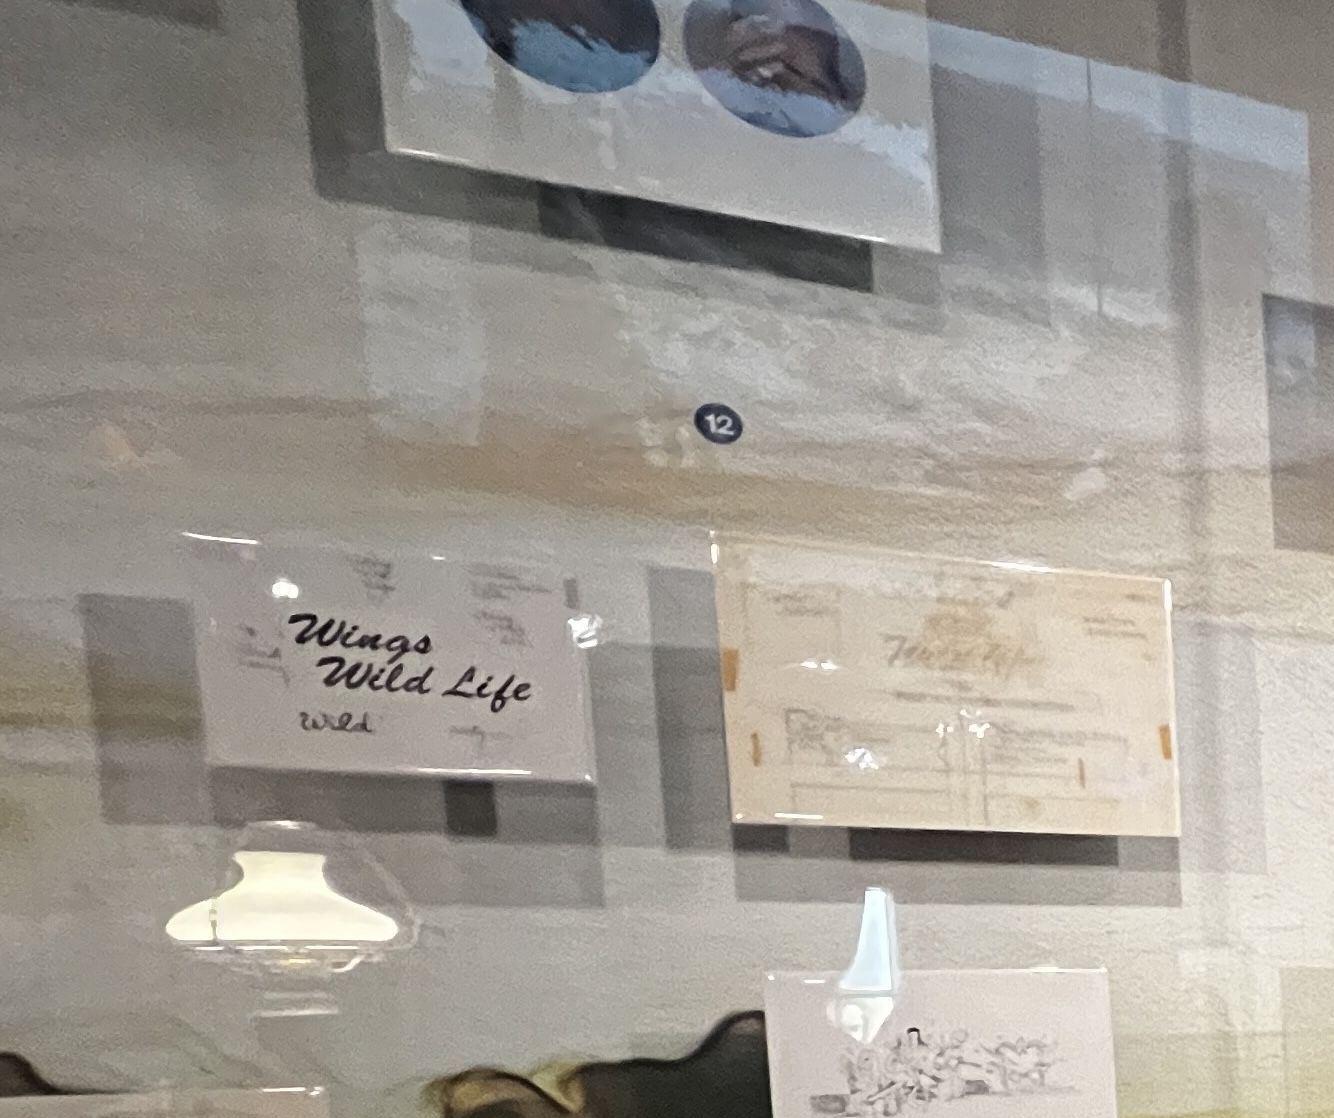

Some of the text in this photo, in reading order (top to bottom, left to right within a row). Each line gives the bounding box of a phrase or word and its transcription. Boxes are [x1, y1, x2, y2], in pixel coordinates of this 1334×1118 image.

[704, 413, 735, 436] 12
[288, 613, 433, 665] Wings
[316, 656, 436, 694] Wild
[442, 666, 534, 713] Life
